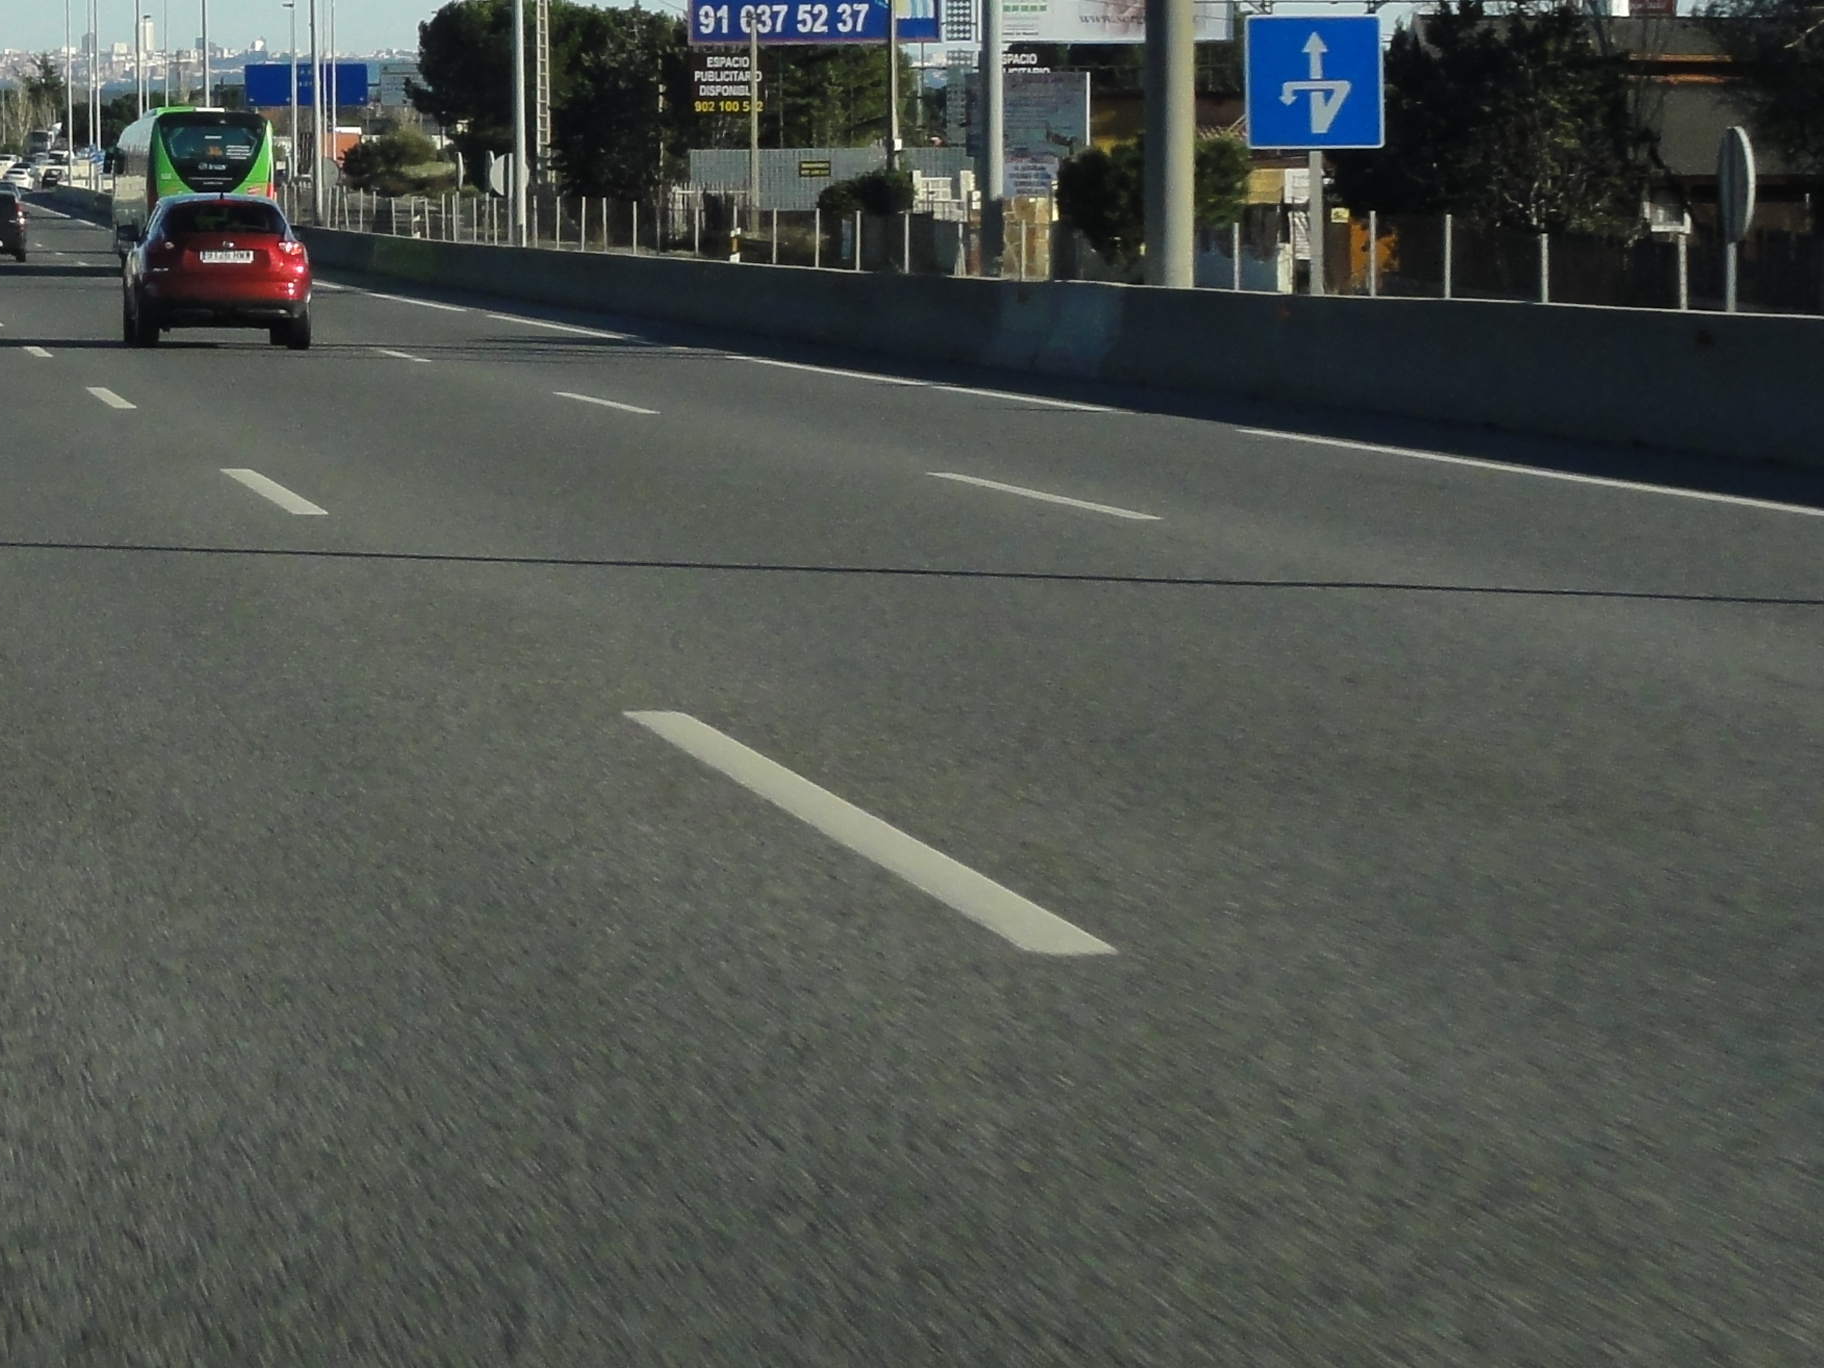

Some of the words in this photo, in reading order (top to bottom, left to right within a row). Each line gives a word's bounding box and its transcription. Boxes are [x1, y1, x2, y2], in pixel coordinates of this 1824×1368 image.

[699, 5, 728, 33] 91
[796, 4, 828, 33] 52
[837, 3, 869, 32] 37
[706, 56, 750, 68] ESPACIO
[1002, 53, 1038, 65] SPACIO
[694, 70, 763, 82] PUBLICITARO
[699, 85, 751, 96] DISPONIBL
[694, 101, 715, 112] 902
[719, 101, 740, 112] 100
[742, 101, 764, 112] 52
